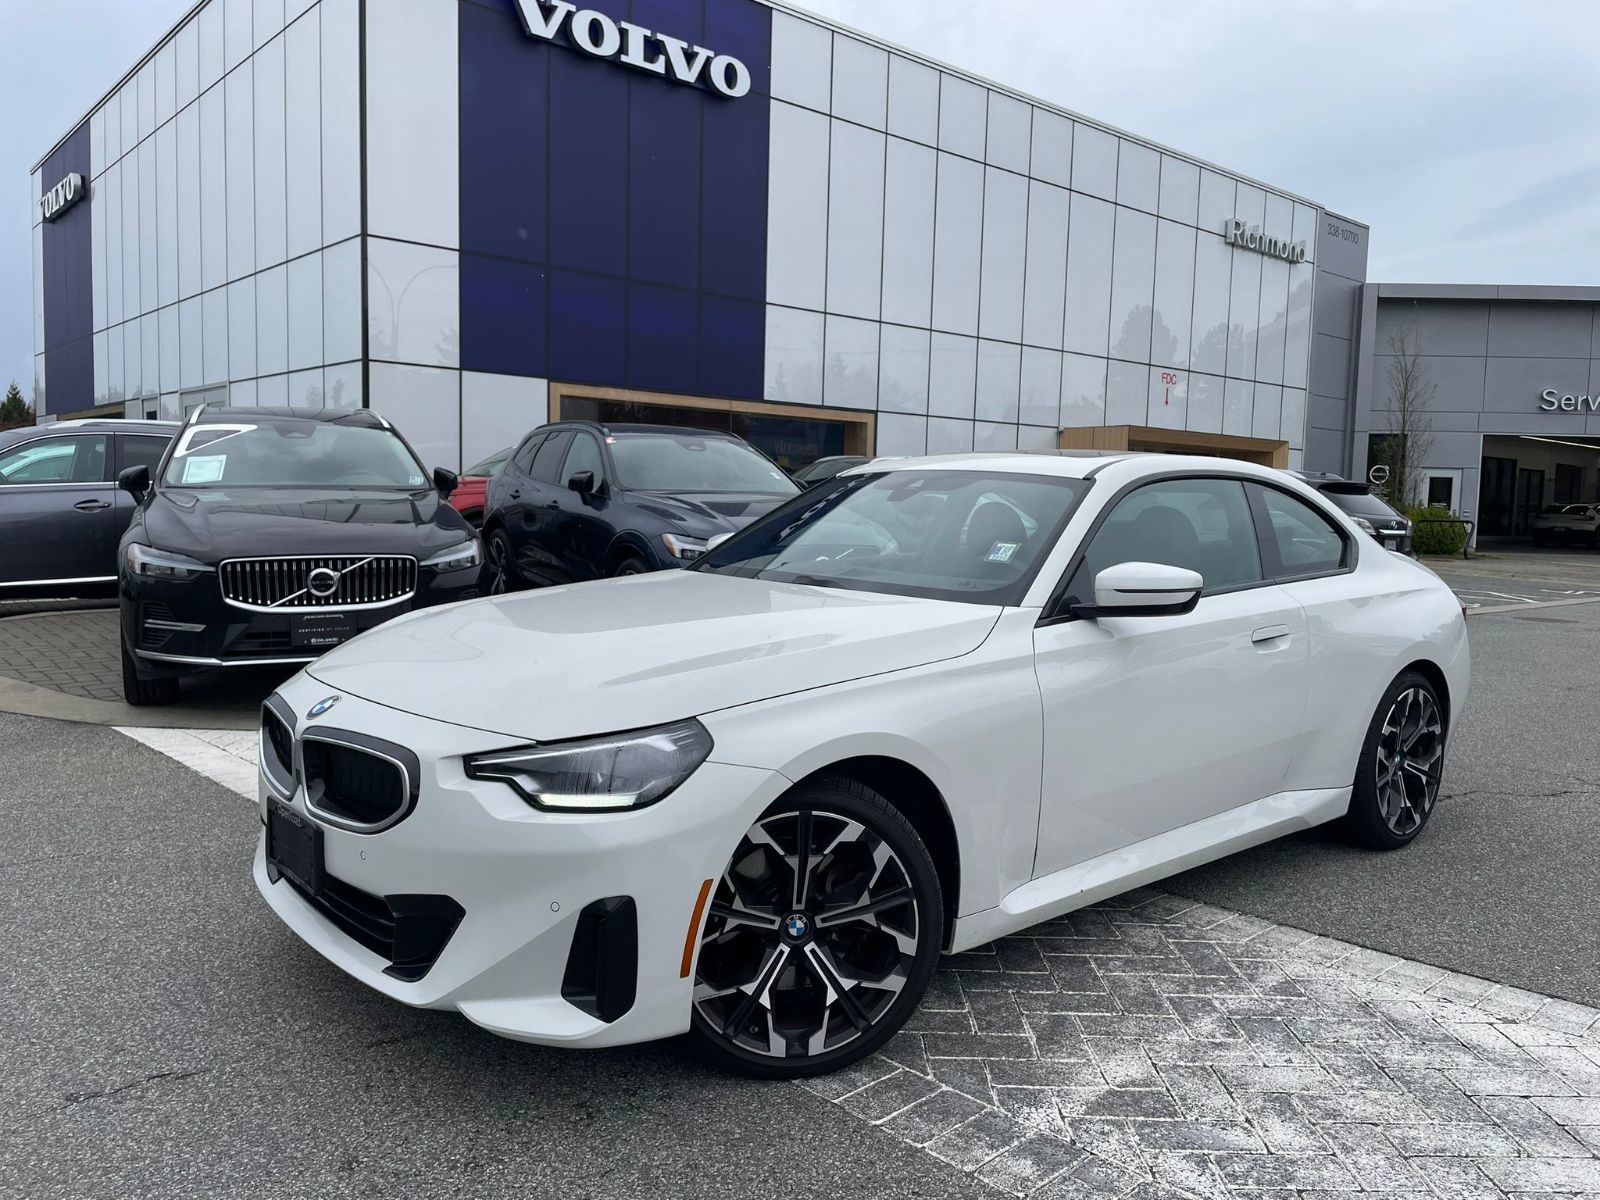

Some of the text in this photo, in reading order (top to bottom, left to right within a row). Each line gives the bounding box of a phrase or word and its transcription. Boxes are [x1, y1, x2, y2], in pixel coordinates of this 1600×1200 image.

[518, 0, 751, 98] VOLVO
[37, 172, 76, 218] VOLVO
[1229, 218, 1306, 263] Richmond
[1326, 223, 1359, 245] 338-10700
[1161, 372, 1177, 385] FDC
[1541, 388, 1600, 411] Serv
